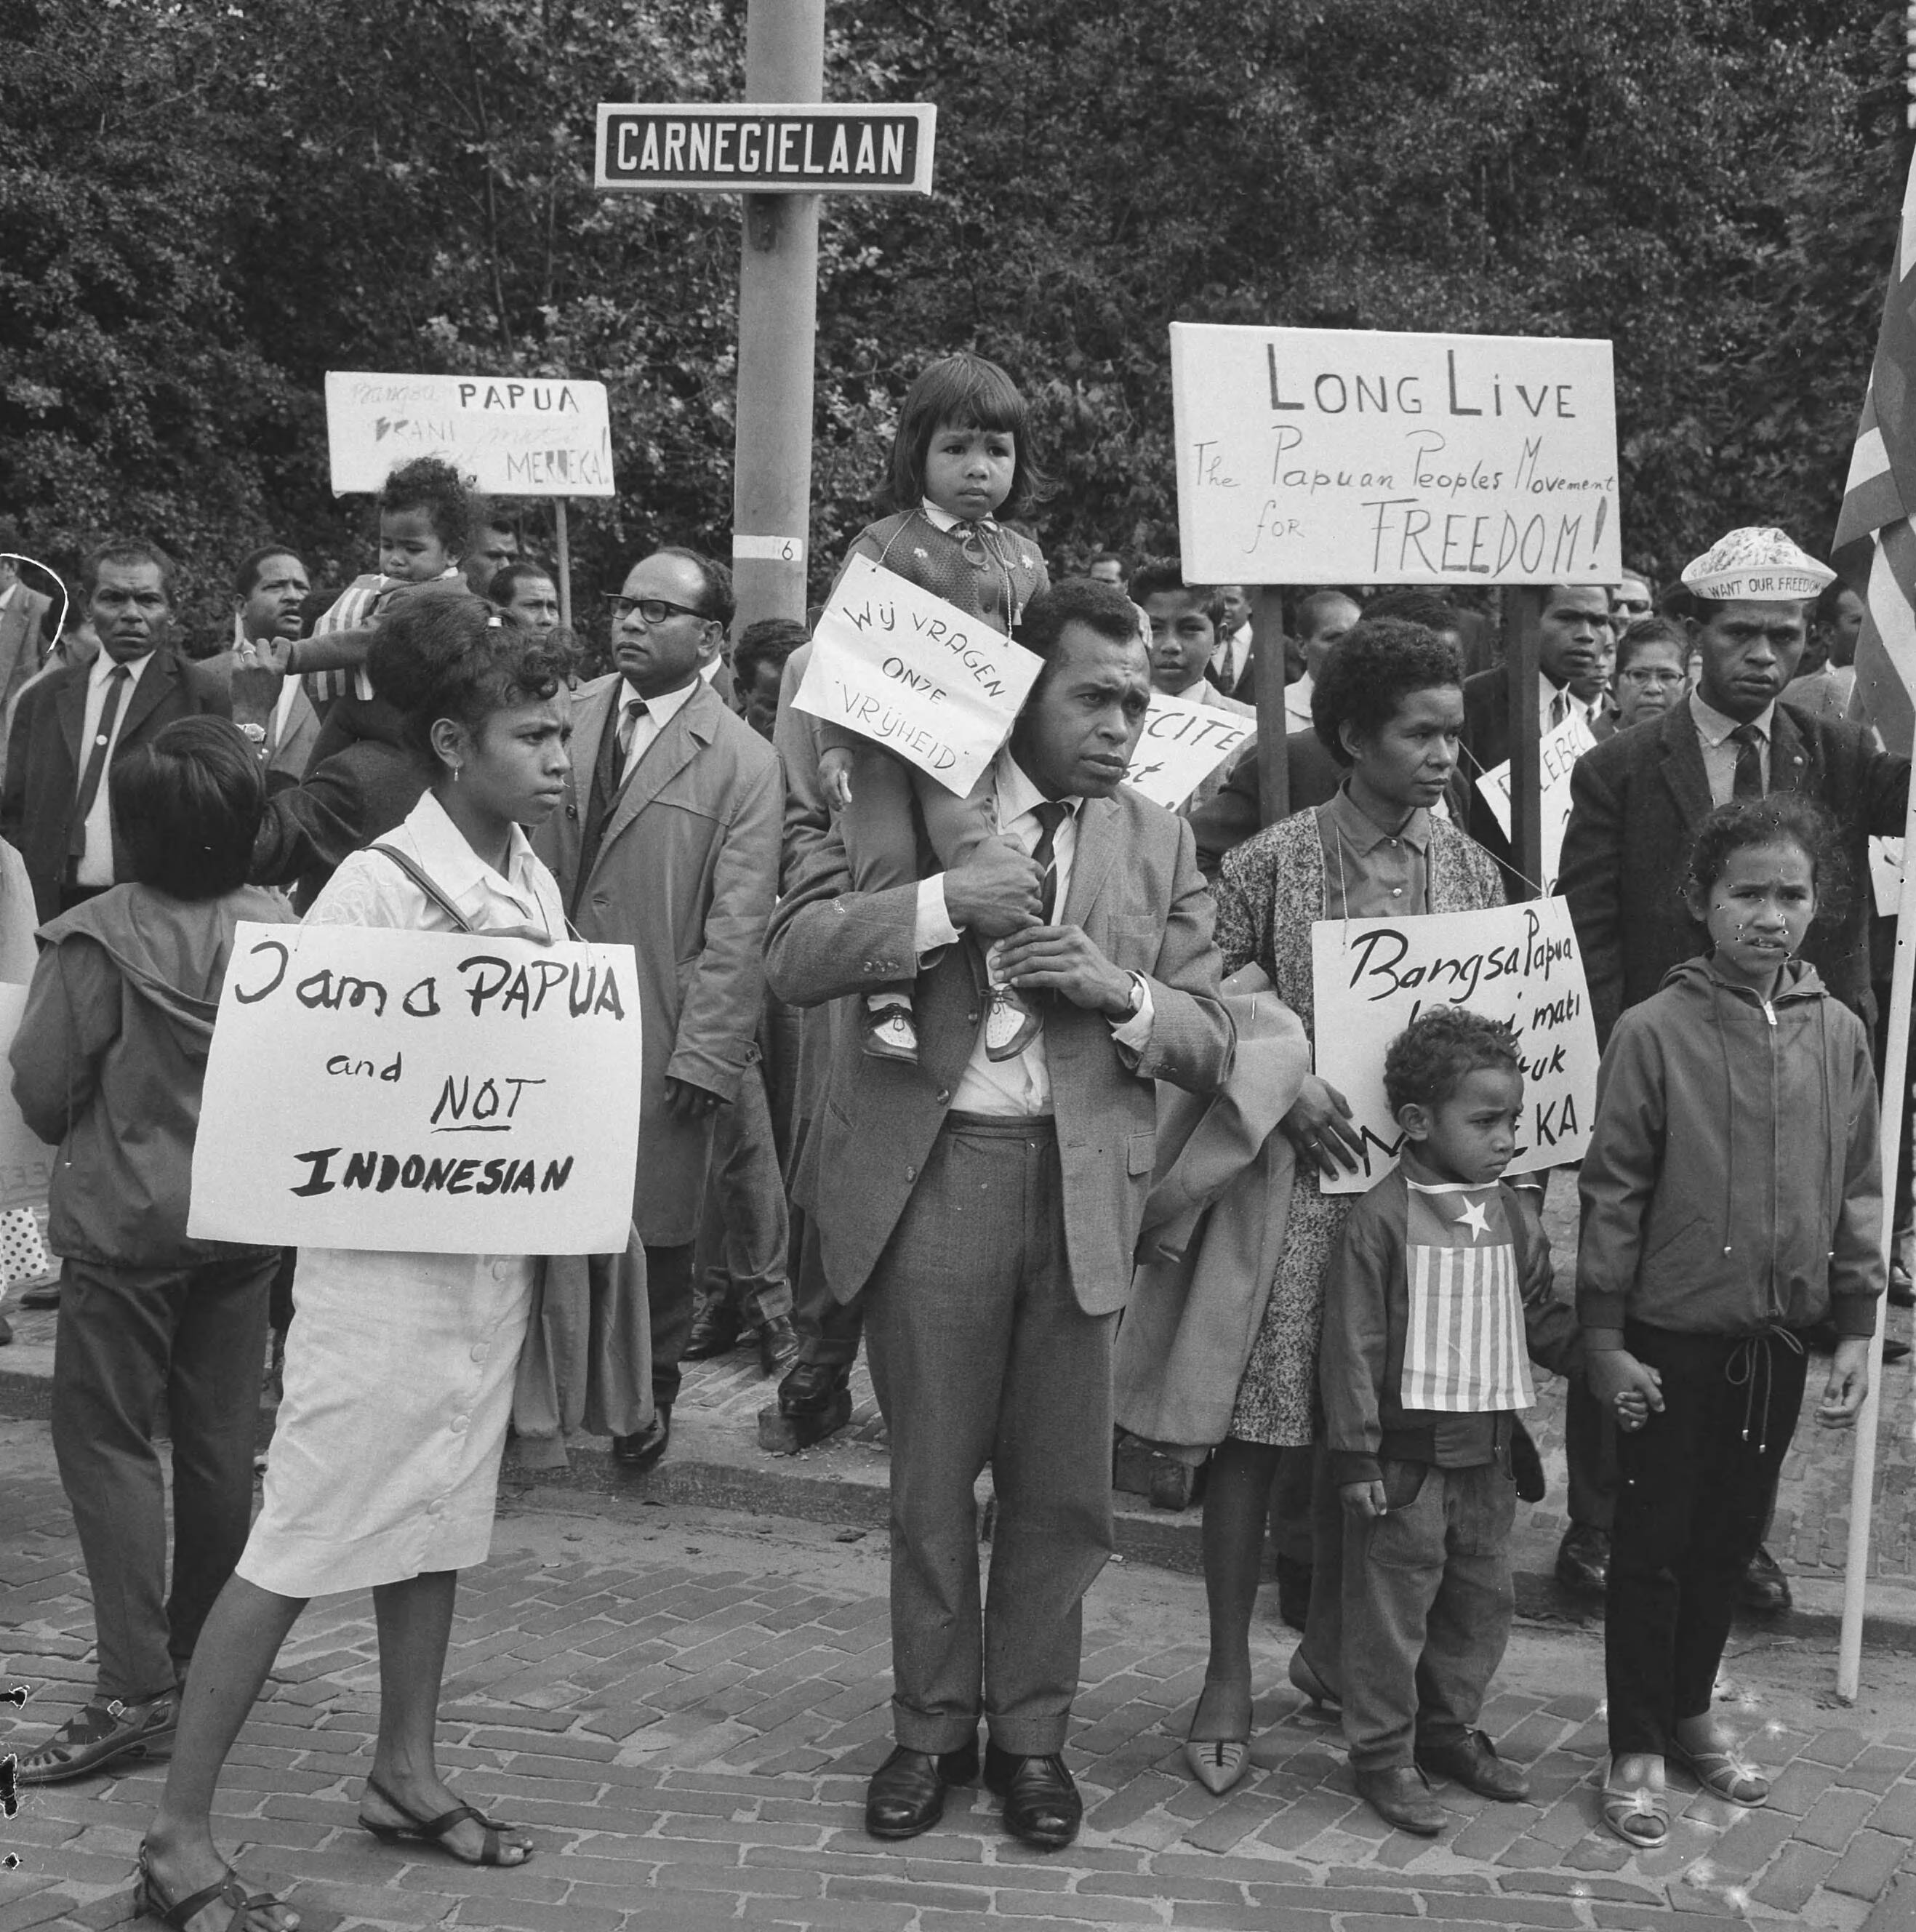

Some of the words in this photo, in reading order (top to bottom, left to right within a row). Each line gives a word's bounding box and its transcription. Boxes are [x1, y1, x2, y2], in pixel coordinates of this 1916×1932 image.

[616, 121, 906, 176] CARNEGIELAAN
[457, 383, 580, 413] PAPUA
[1267, 342, 1422, 414] LONG
[1193, 441, 1241, 486] The
[1271, 425, 1395, 495] Papuan
[1406, 430, 1504, 497] Peoples
[1515, 436, 1616, 492] Movement
[782, 540, 793, 561] 6
[1361, 496, 1608, 578] FREEDOM!
[1708, 580, 1742, 598] WANT
[1748, 577, 1773, 593] OUR
[881, 657, 947, 705] ONZE
[912, 612, 1006, 698] VRAGEN
[1349, 928, 1520, 1003] Bangsa
[1523, 908, 1573, 982] Papua
[295, 969, 388, 1017] am
[402, 977, 441, 1017] a
[457, 954, 626, 1021] PAPUA
[1531, 989, 1580, 1030] mati
[326, 1051, 402, 1083] and
[430, 1074, 547, 1126] NOT
[287, 1147, 574, 1198] INDONESIAN
